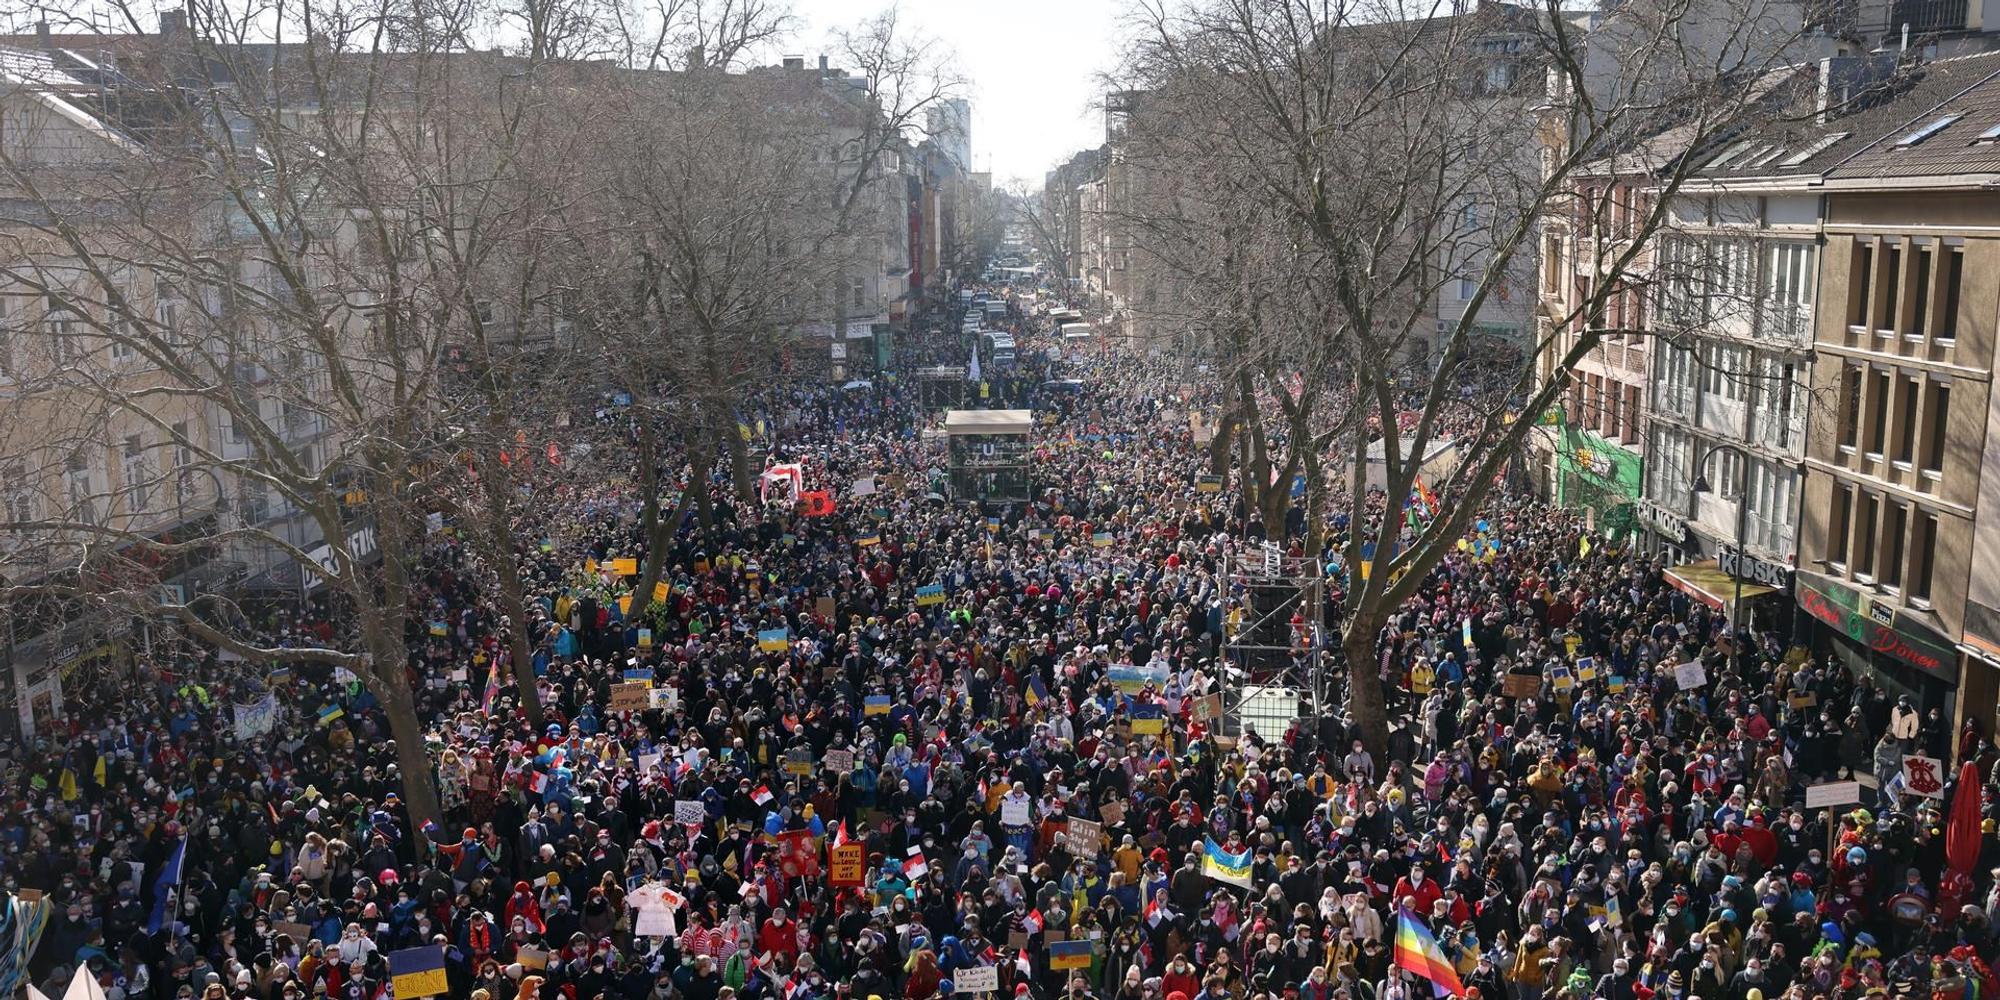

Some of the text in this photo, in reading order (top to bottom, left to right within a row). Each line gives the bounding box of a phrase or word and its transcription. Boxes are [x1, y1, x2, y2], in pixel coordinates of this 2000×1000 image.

[983, 443, 995, 456] U
[1721, 554, 1781, 585] KIOSK
[1871, 626, 1941, 669] Döner
